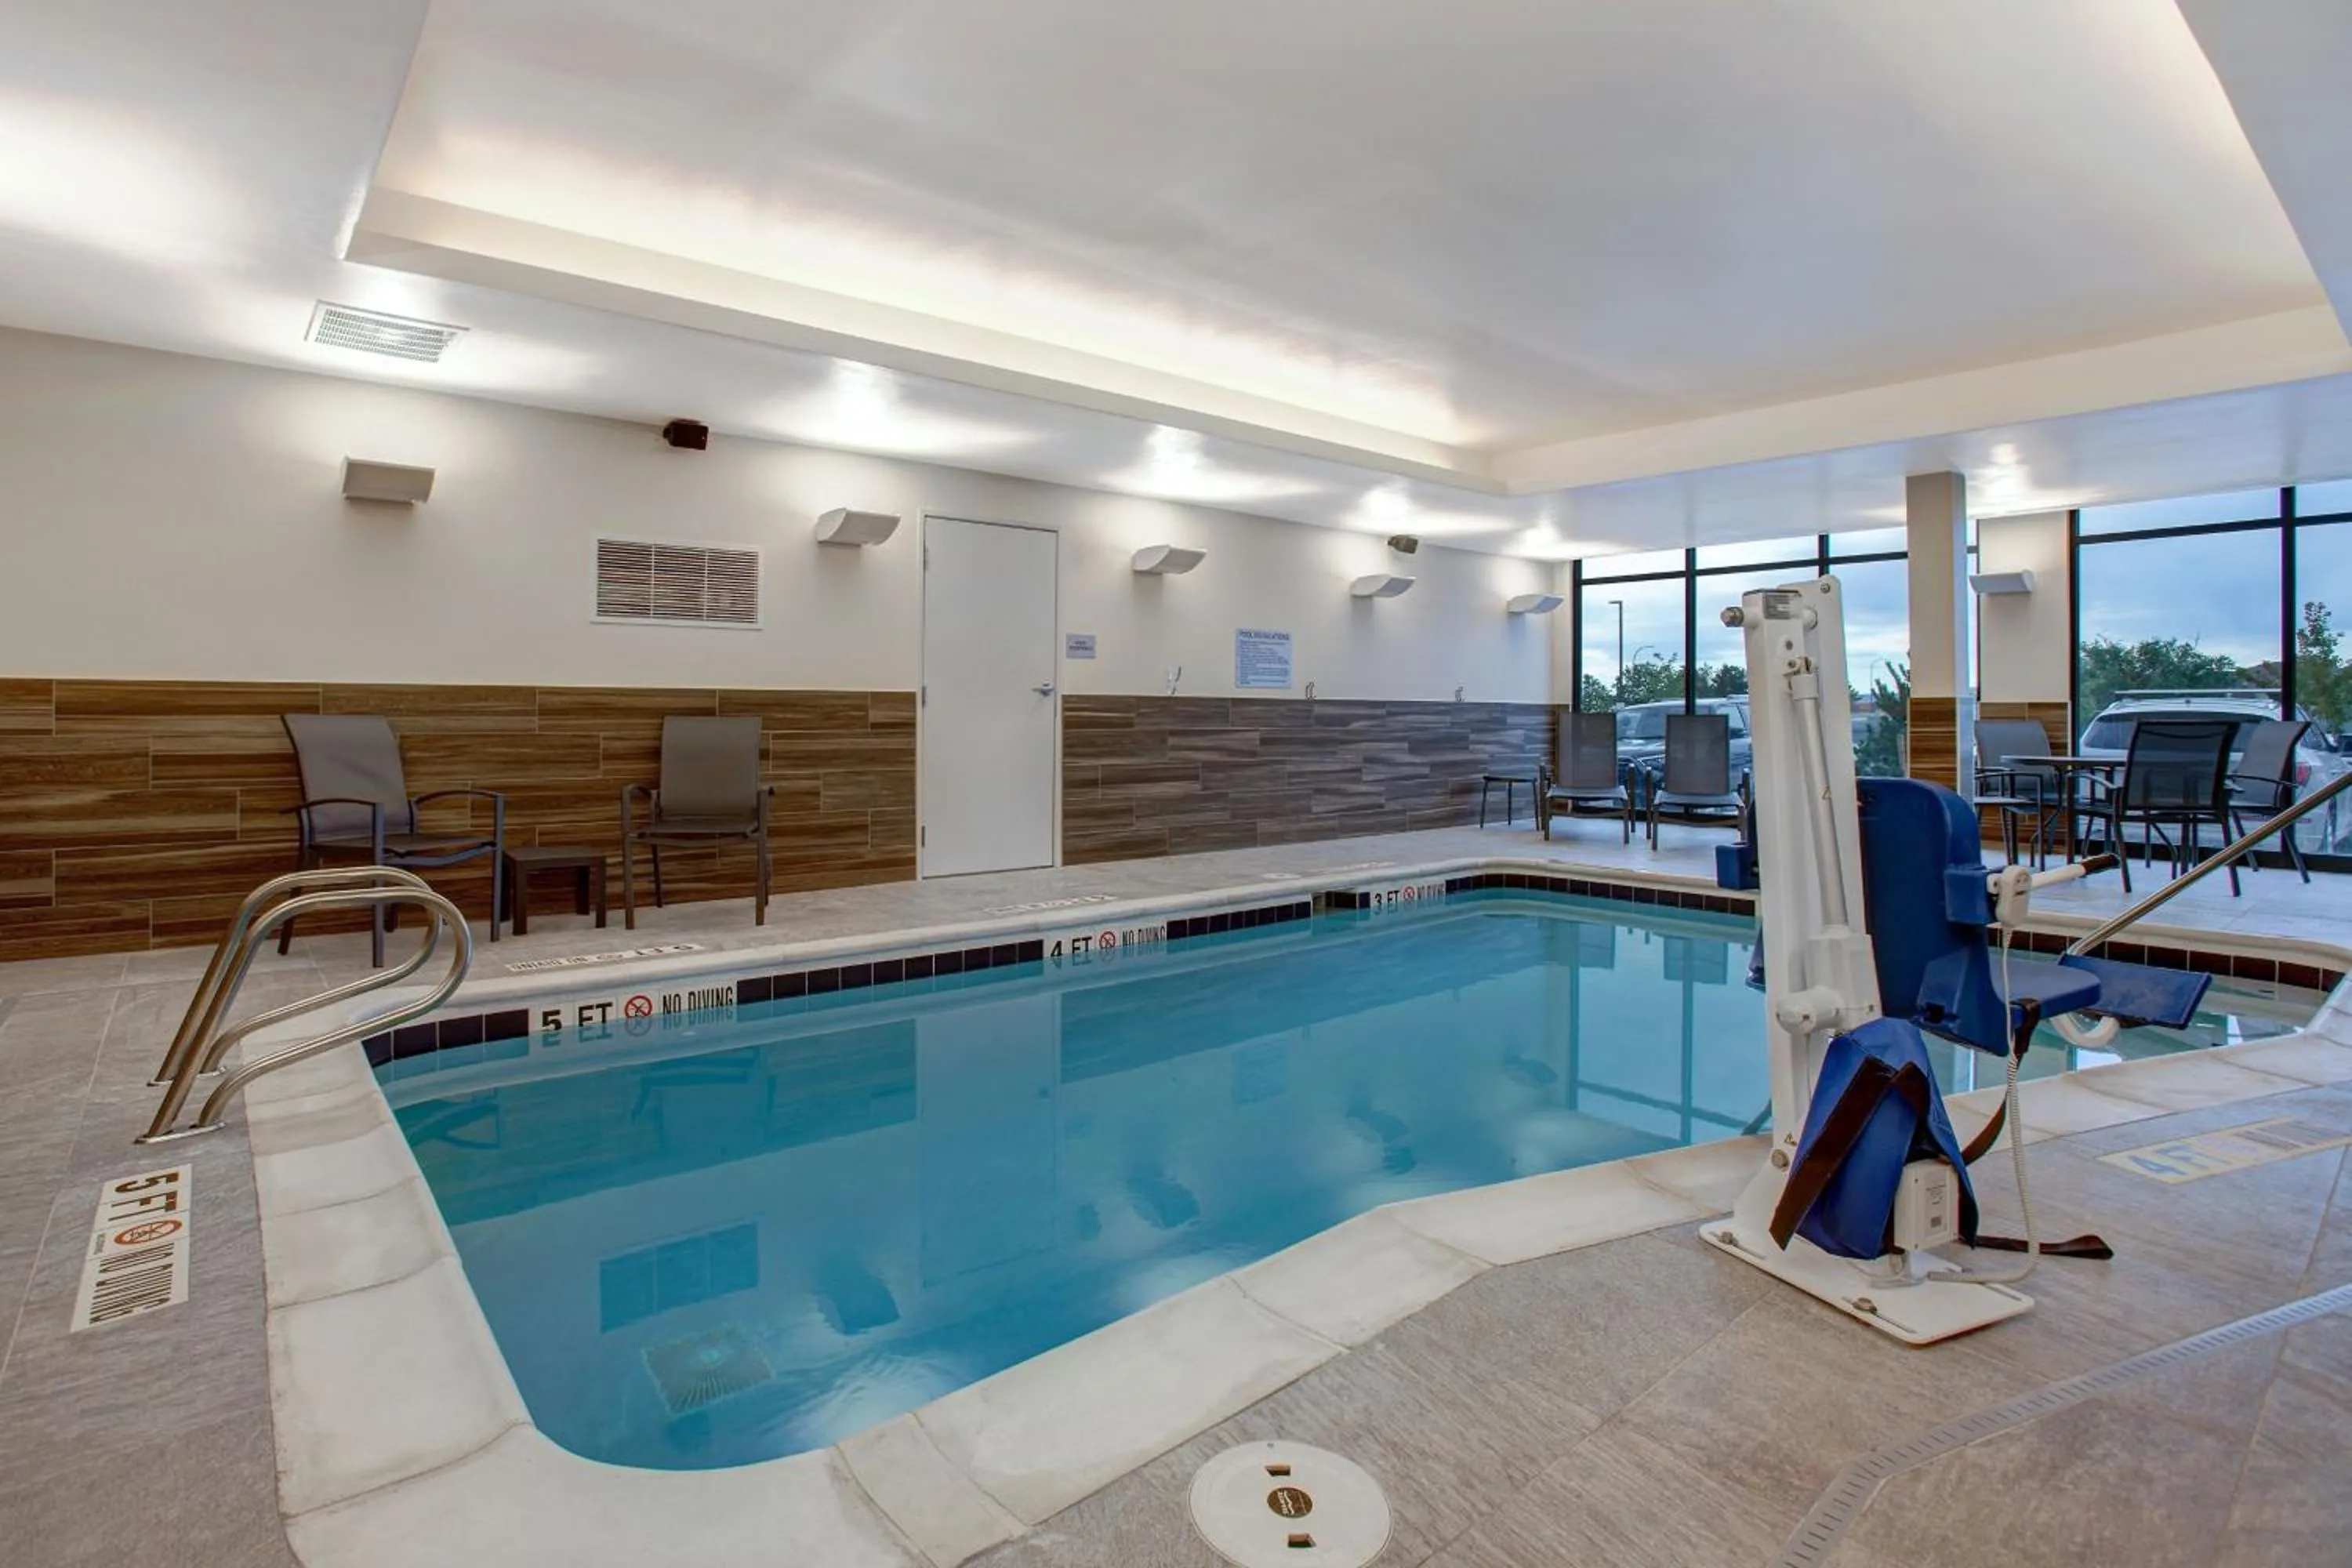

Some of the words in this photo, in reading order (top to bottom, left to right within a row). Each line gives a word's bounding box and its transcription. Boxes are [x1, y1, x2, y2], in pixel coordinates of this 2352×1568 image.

[1051, 940, 1063, 957] 4
[1072, 936, 1093, 954] FT
[1122, 930, 1134, 947] NO
[542, 1009, 562, 1031] 5
[578, 1002, 613, 1027] FT
[662, 993, 681, 1015] NO
[688, 985, 733, 1011] DIVING
[114, 1171, 180, 1193] 5
[107, 1190, 178, 1221] FT
[99, 1242, 175, 1274] NO
[89, 1262, 174, 1325] DIVING
